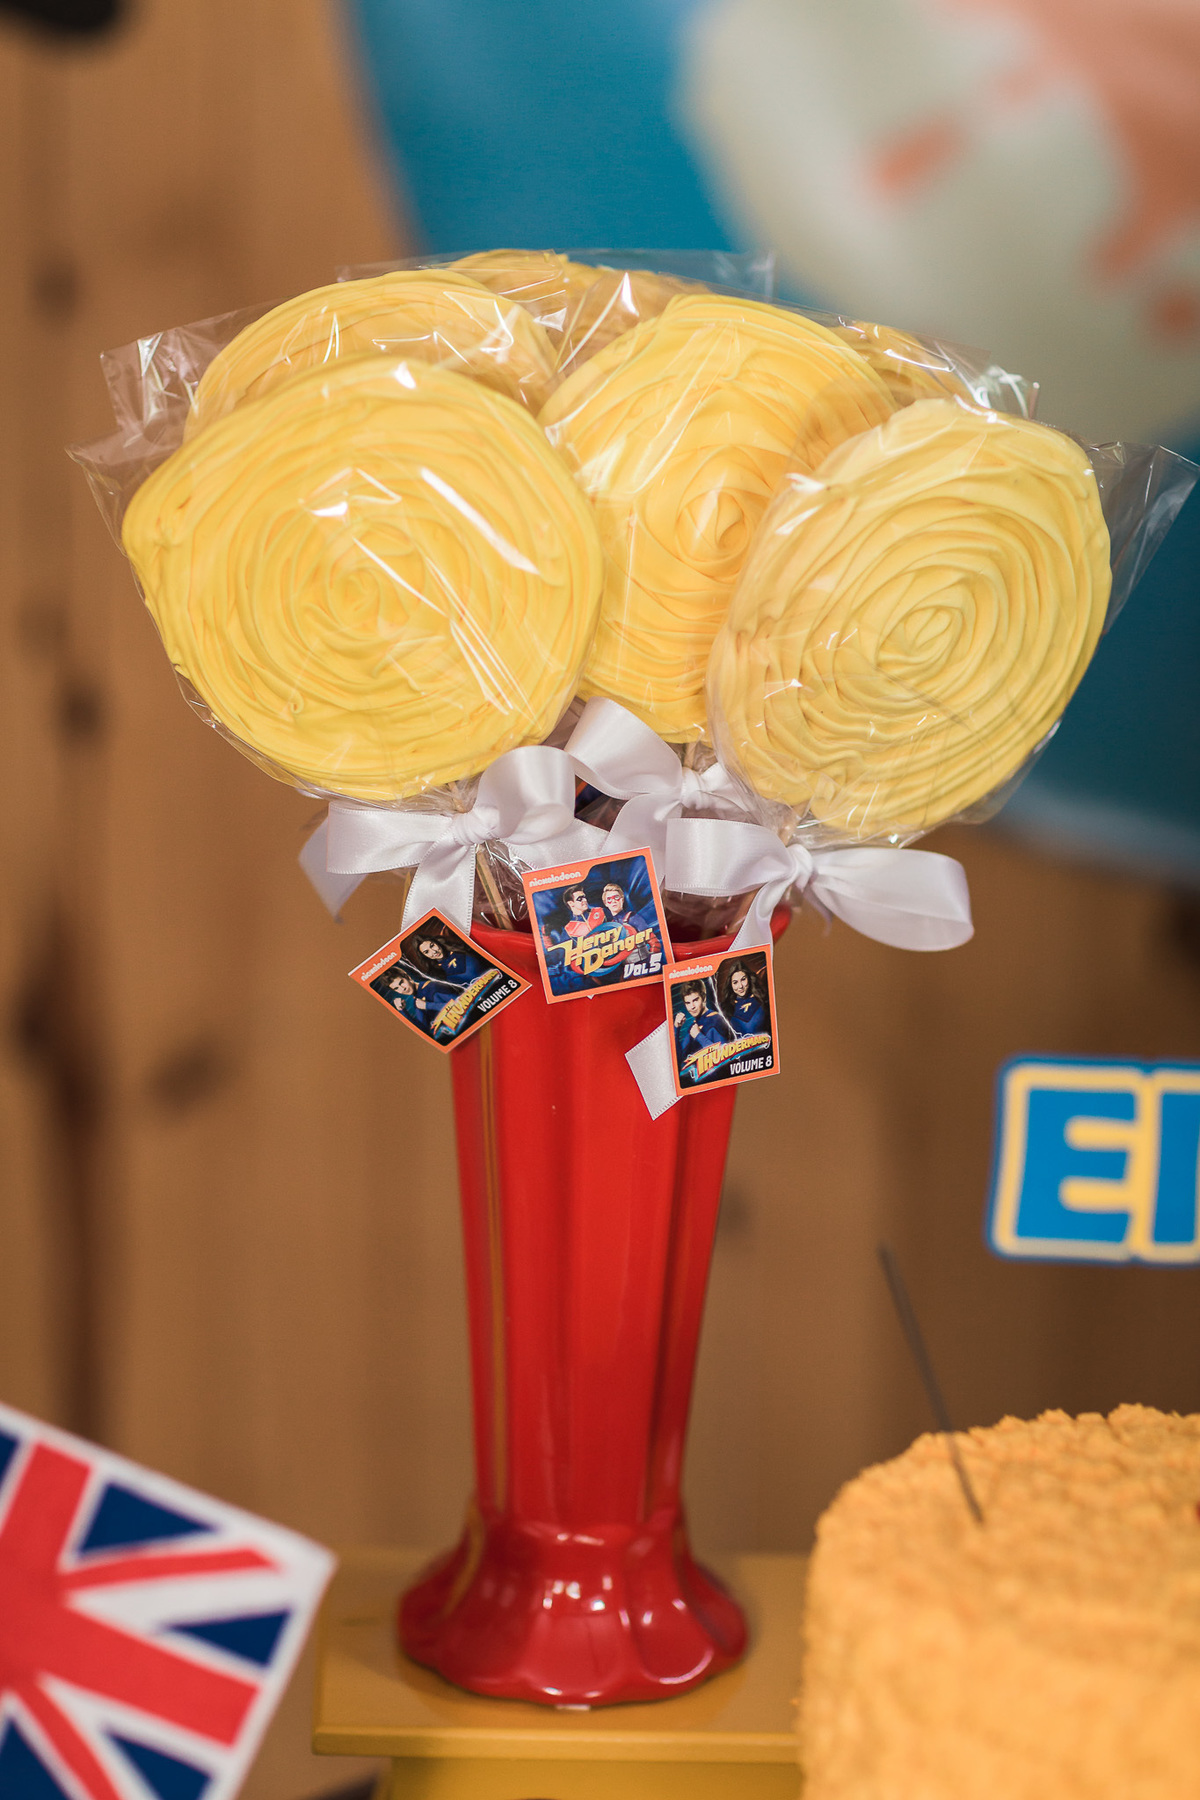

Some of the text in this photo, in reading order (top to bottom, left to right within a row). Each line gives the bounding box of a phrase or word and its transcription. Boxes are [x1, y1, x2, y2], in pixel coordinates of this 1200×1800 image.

[547, 926, 621, 967] Henry
[570, 927, 653, 976] Danger
[649, 952, 662, 973] 5
[477, 987, 510, 1013] VOLUME
[509, 979, 518, 990] 8
[730, 1055, 773, 1075] VOLUME 8
